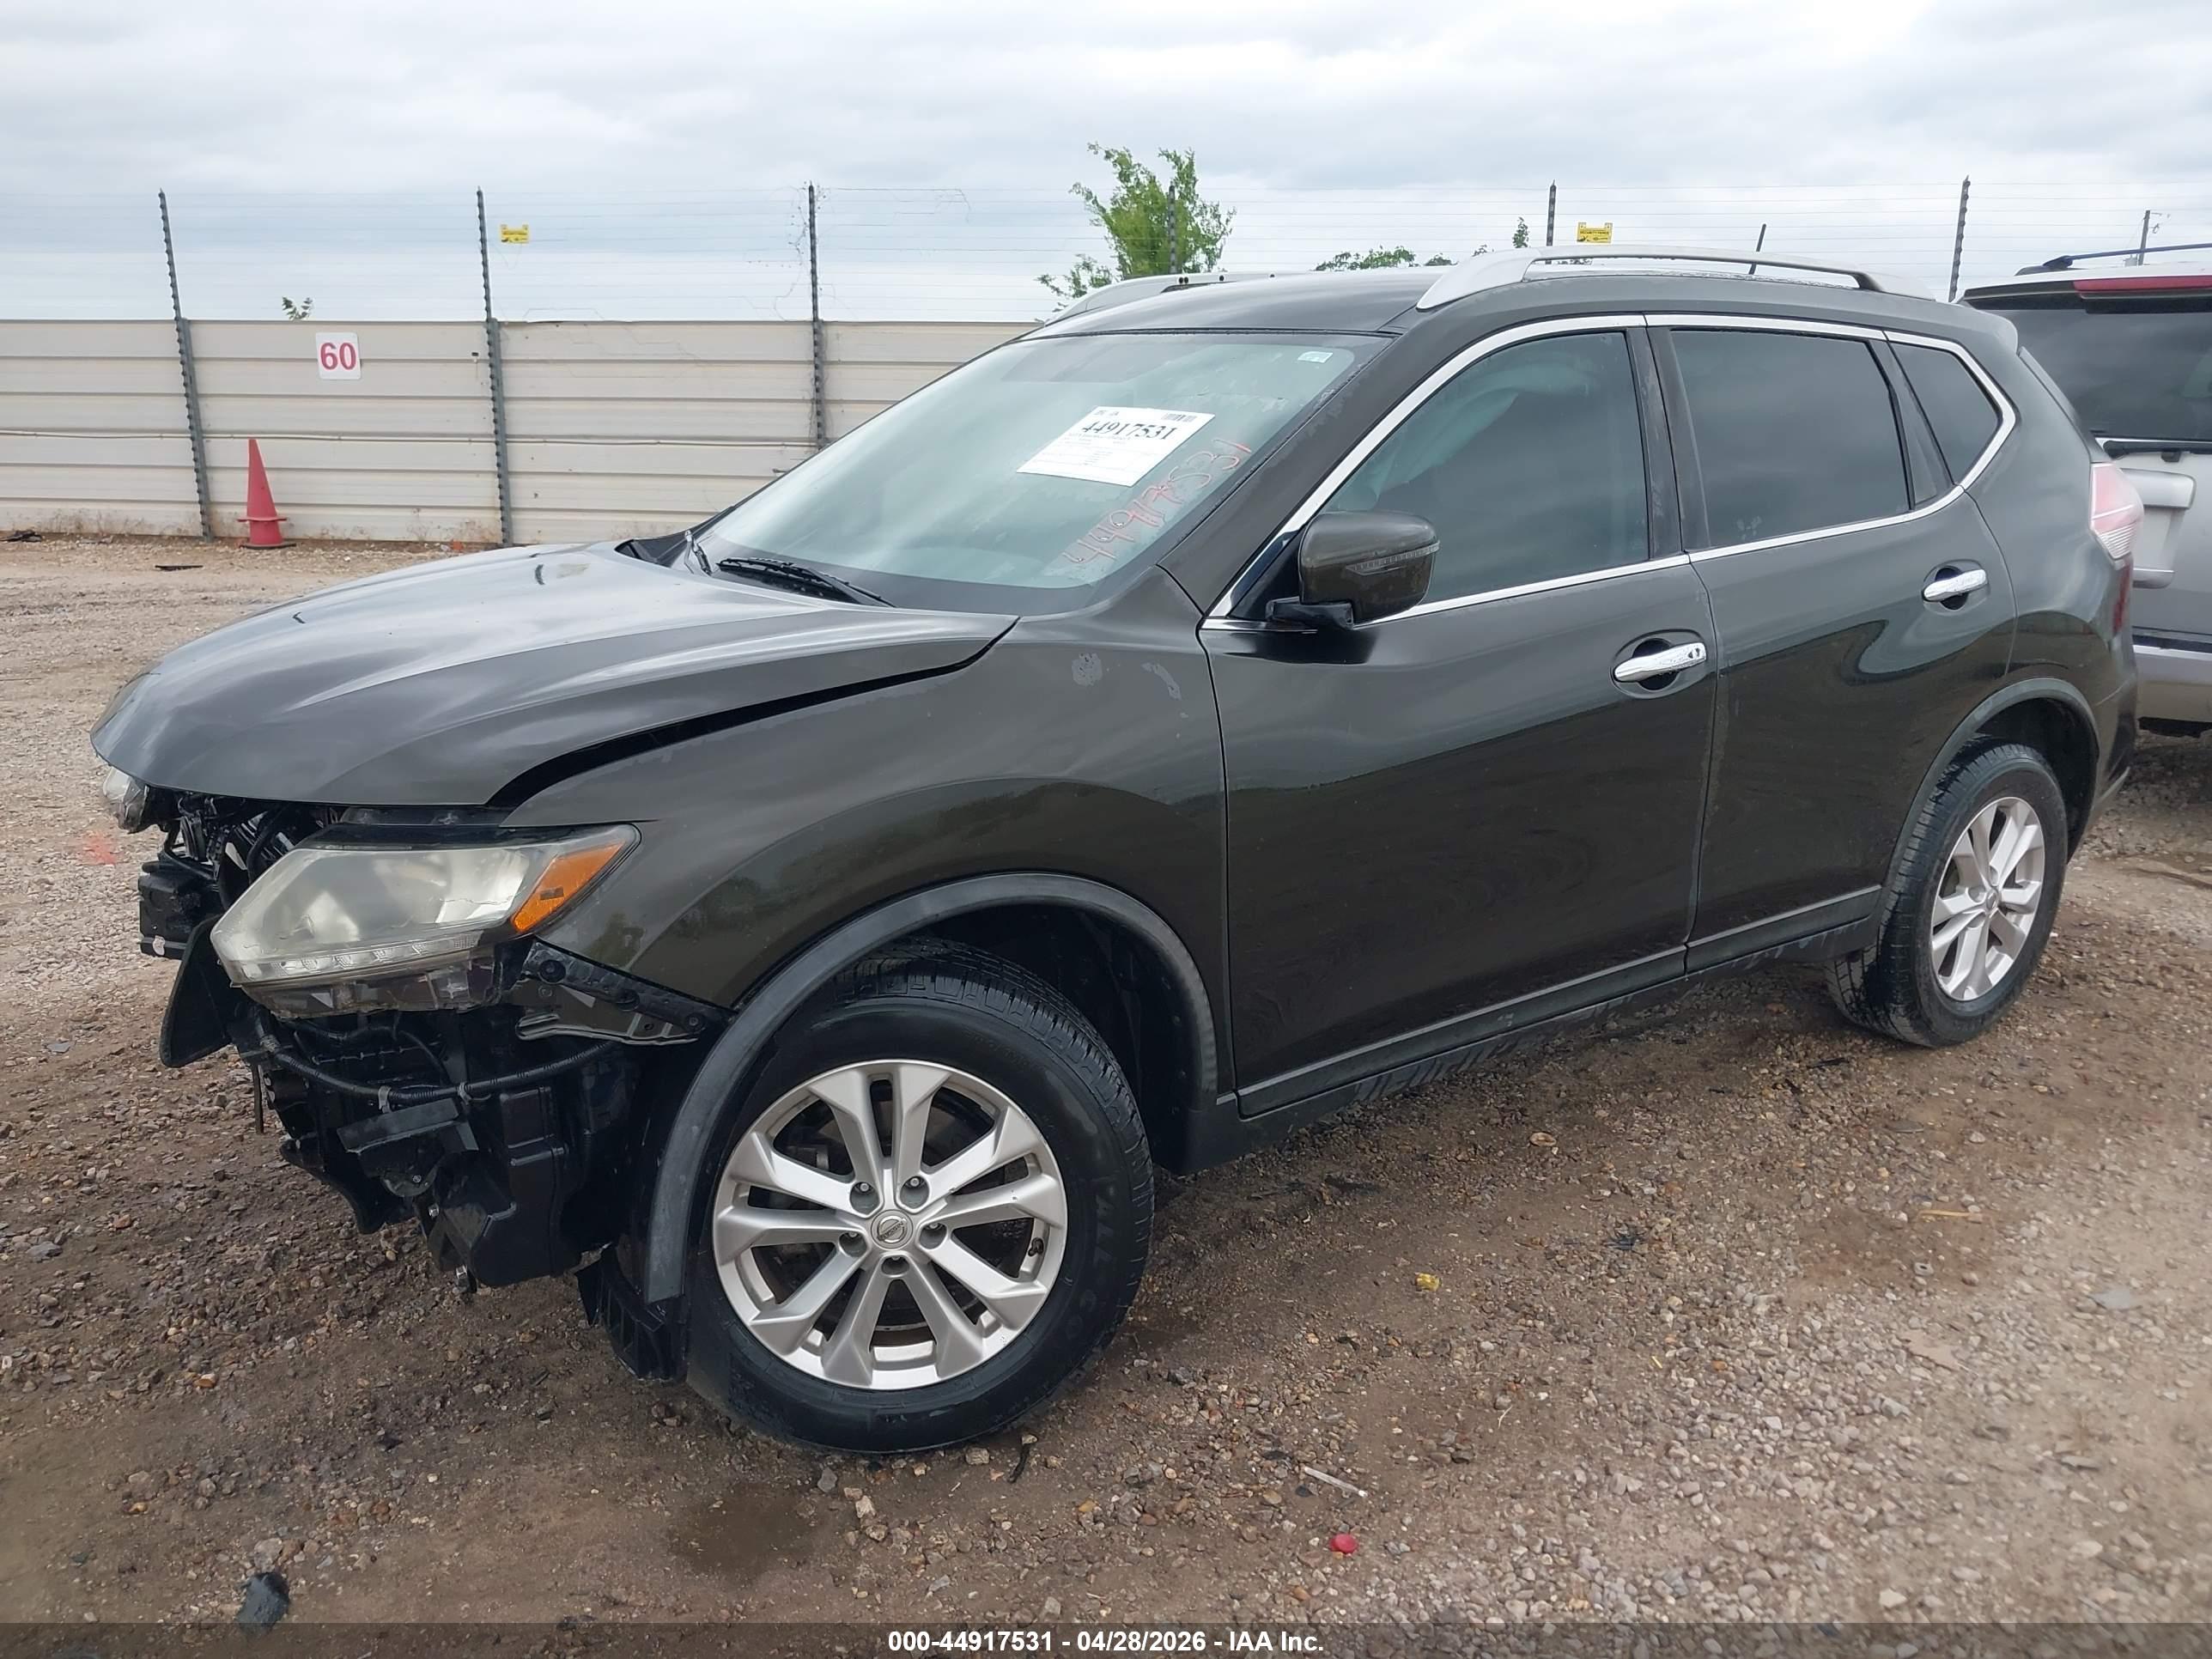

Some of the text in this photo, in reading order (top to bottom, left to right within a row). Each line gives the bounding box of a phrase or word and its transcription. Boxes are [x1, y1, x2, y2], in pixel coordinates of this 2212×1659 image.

[320, 342, 356, 370] 60
[1081, 420, 1177, 441] 44917531
[1060, 438, 1253, 562] 44917531
